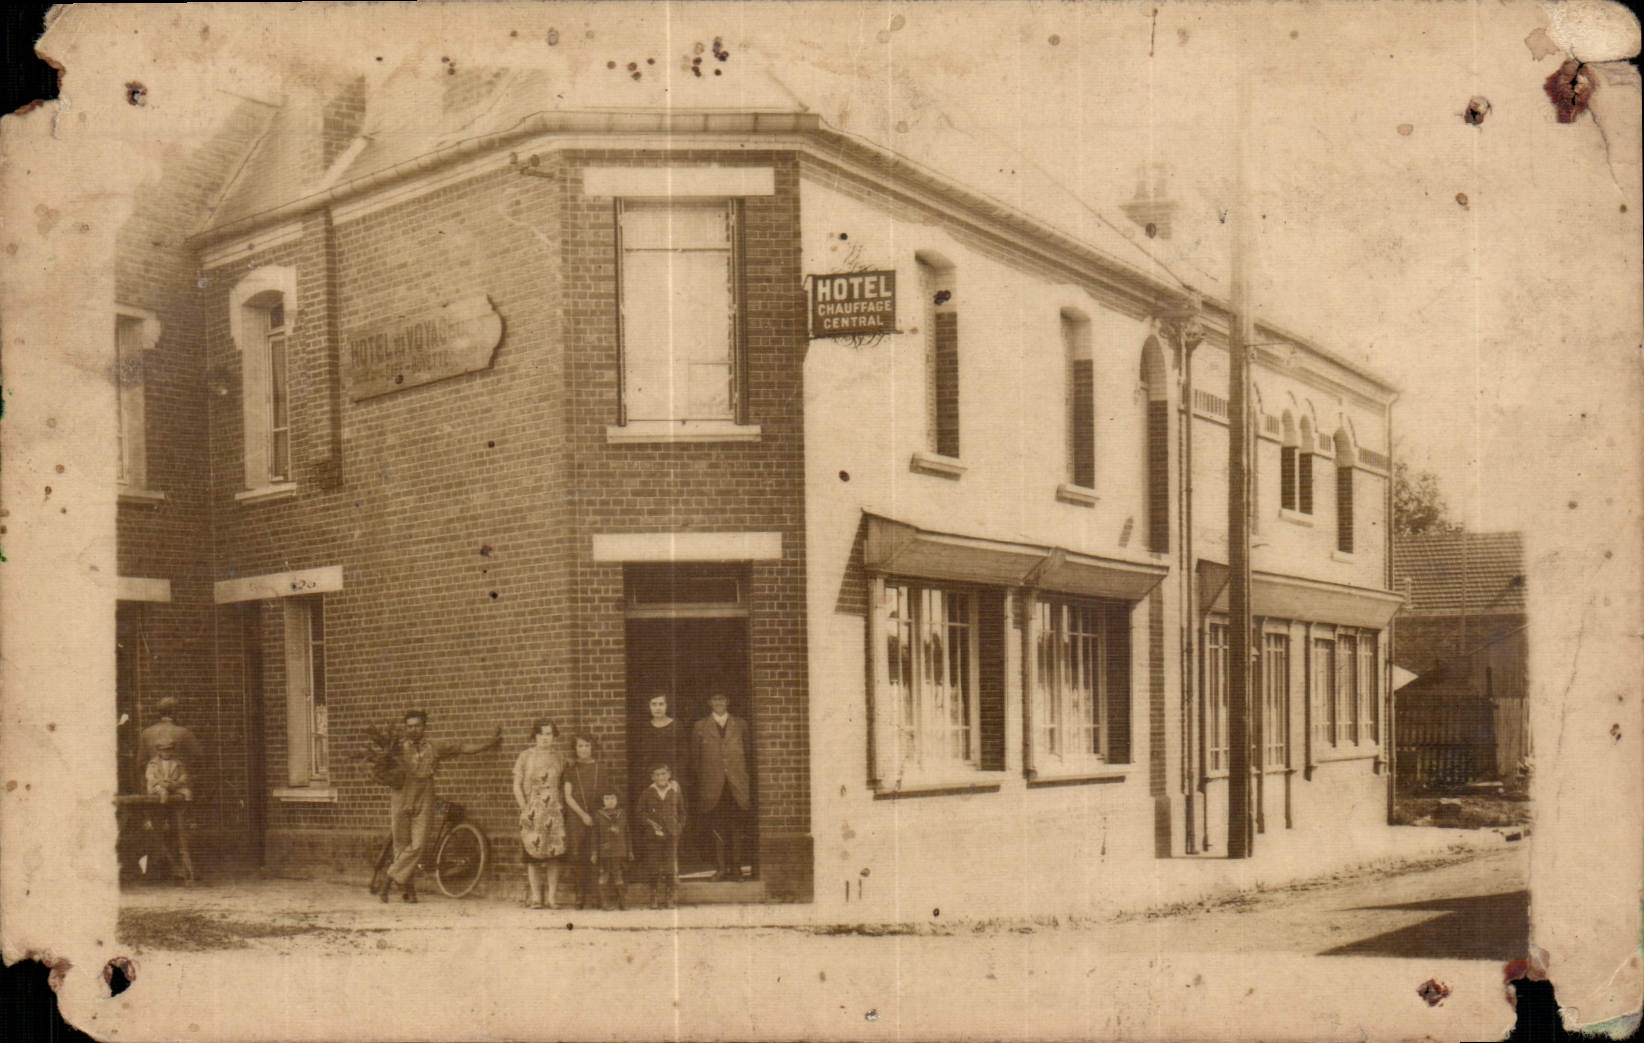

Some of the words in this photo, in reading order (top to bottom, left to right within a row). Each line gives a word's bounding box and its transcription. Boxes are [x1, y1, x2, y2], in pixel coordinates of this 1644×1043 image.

[817, 275, 892, 302] HOTEL
[818, 300, 892, 316] CHAUFFAGE
[824, 315, 884, 329] CENTRAL
[351, 332, 393, 369] HOTEL
